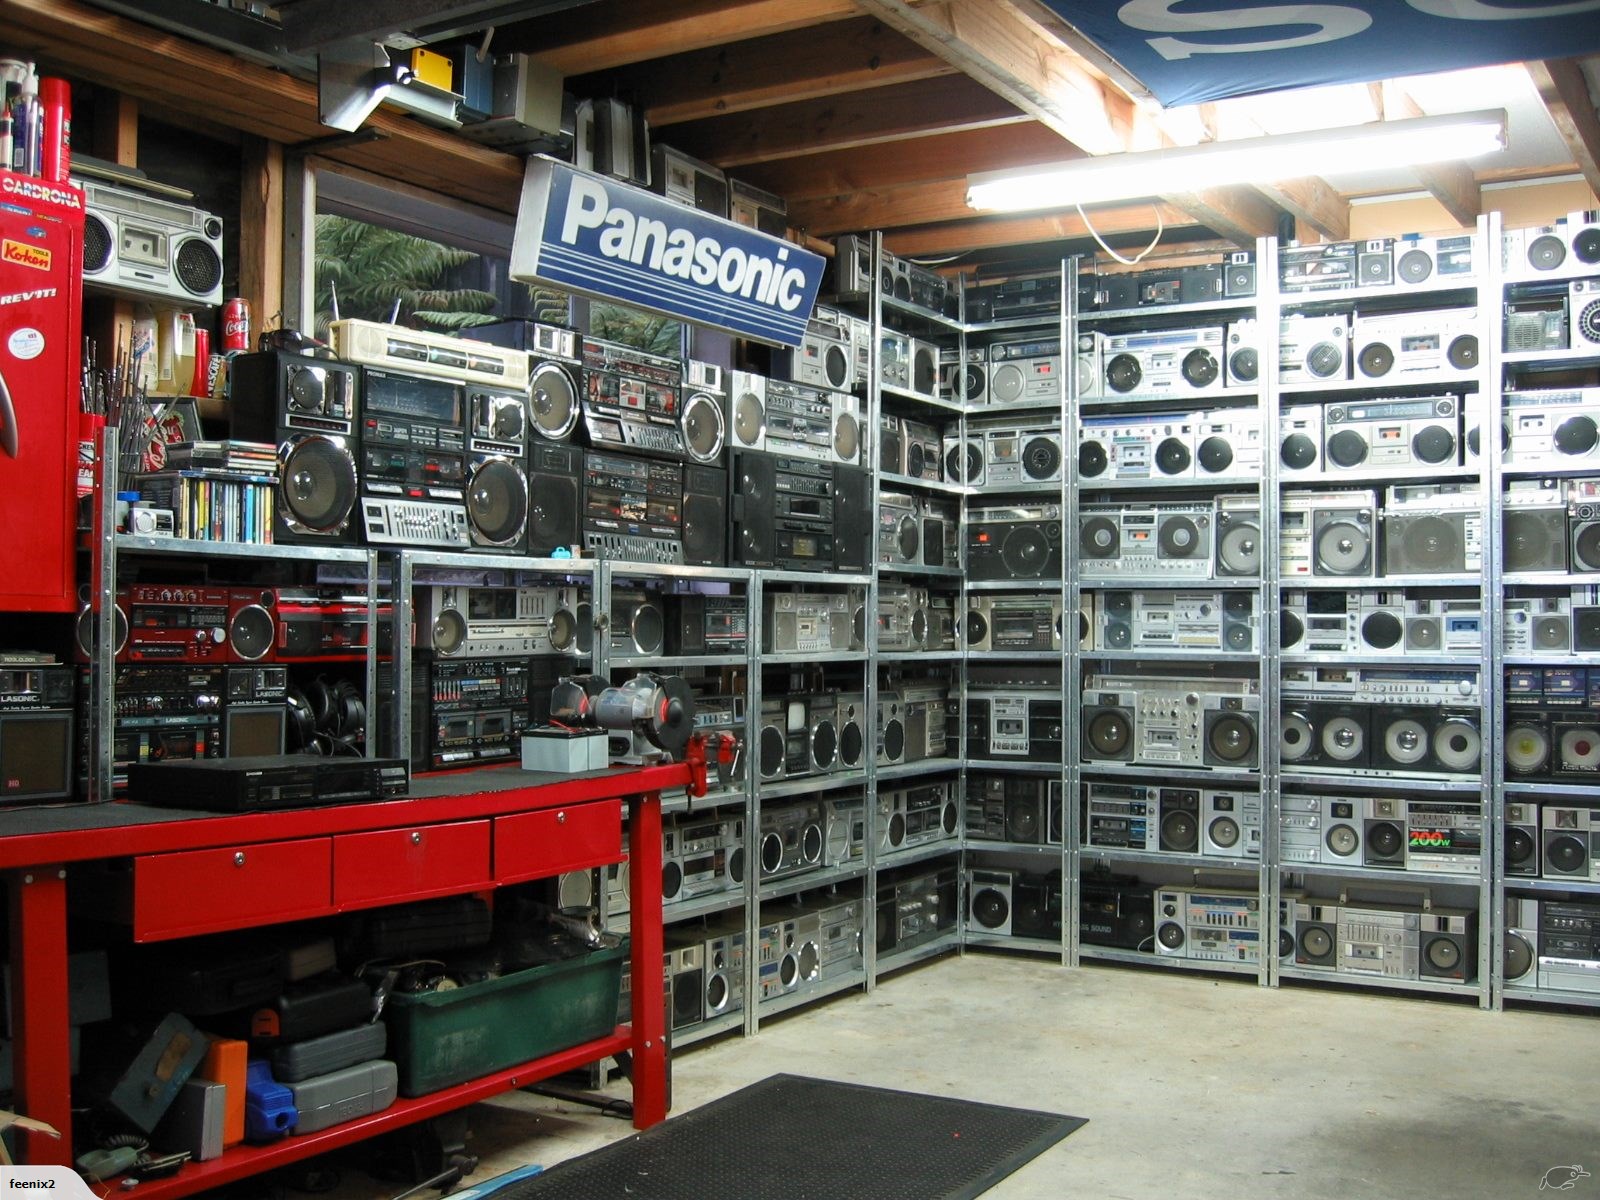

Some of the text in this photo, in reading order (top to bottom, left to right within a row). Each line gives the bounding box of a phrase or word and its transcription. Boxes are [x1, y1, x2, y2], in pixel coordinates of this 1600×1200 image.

[2, 177, 81, 209] CARDRONA
[4, 242, 48, 268] Koken
[561, 174, 806, 312] Panasonic
[1, 695, 38, 703] LASONIC
